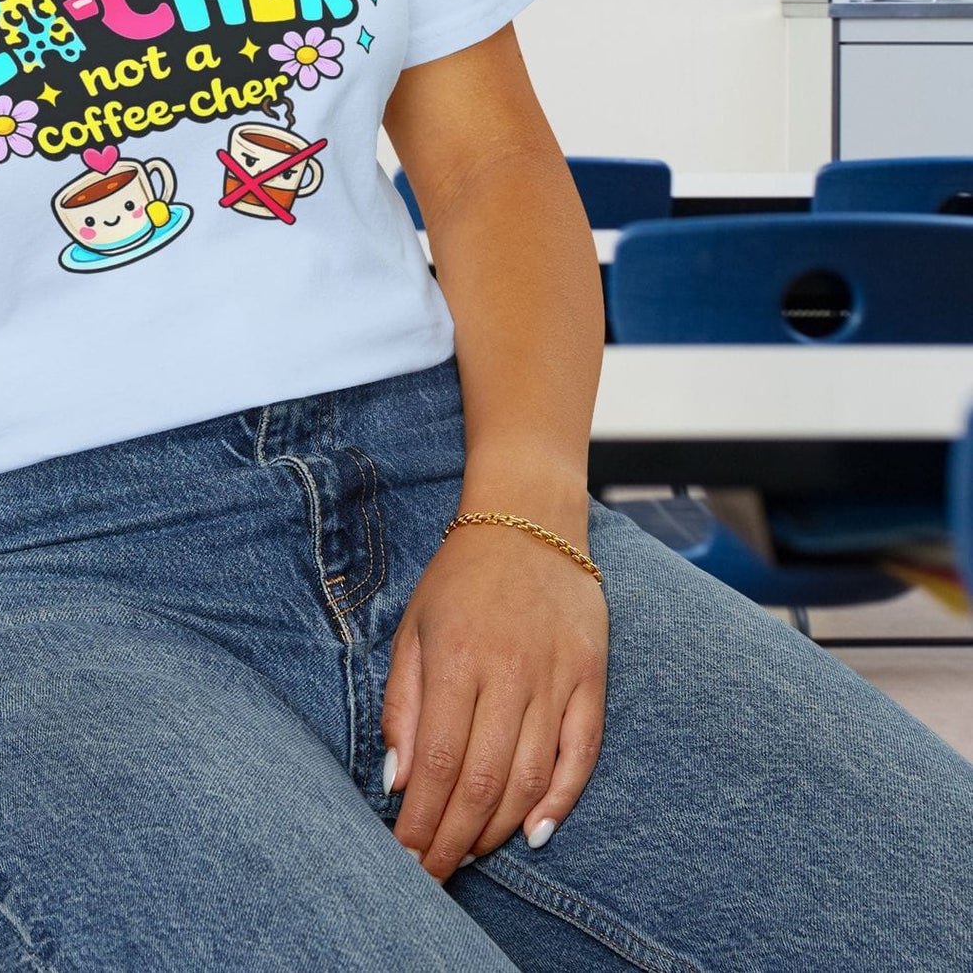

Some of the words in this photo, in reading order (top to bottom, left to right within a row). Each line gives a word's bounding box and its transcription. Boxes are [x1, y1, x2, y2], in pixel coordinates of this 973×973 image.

[81, 46, 171, 96] not
[186, 44, 221, 72] a
[38, 74, 289, 154] coffee-cher
